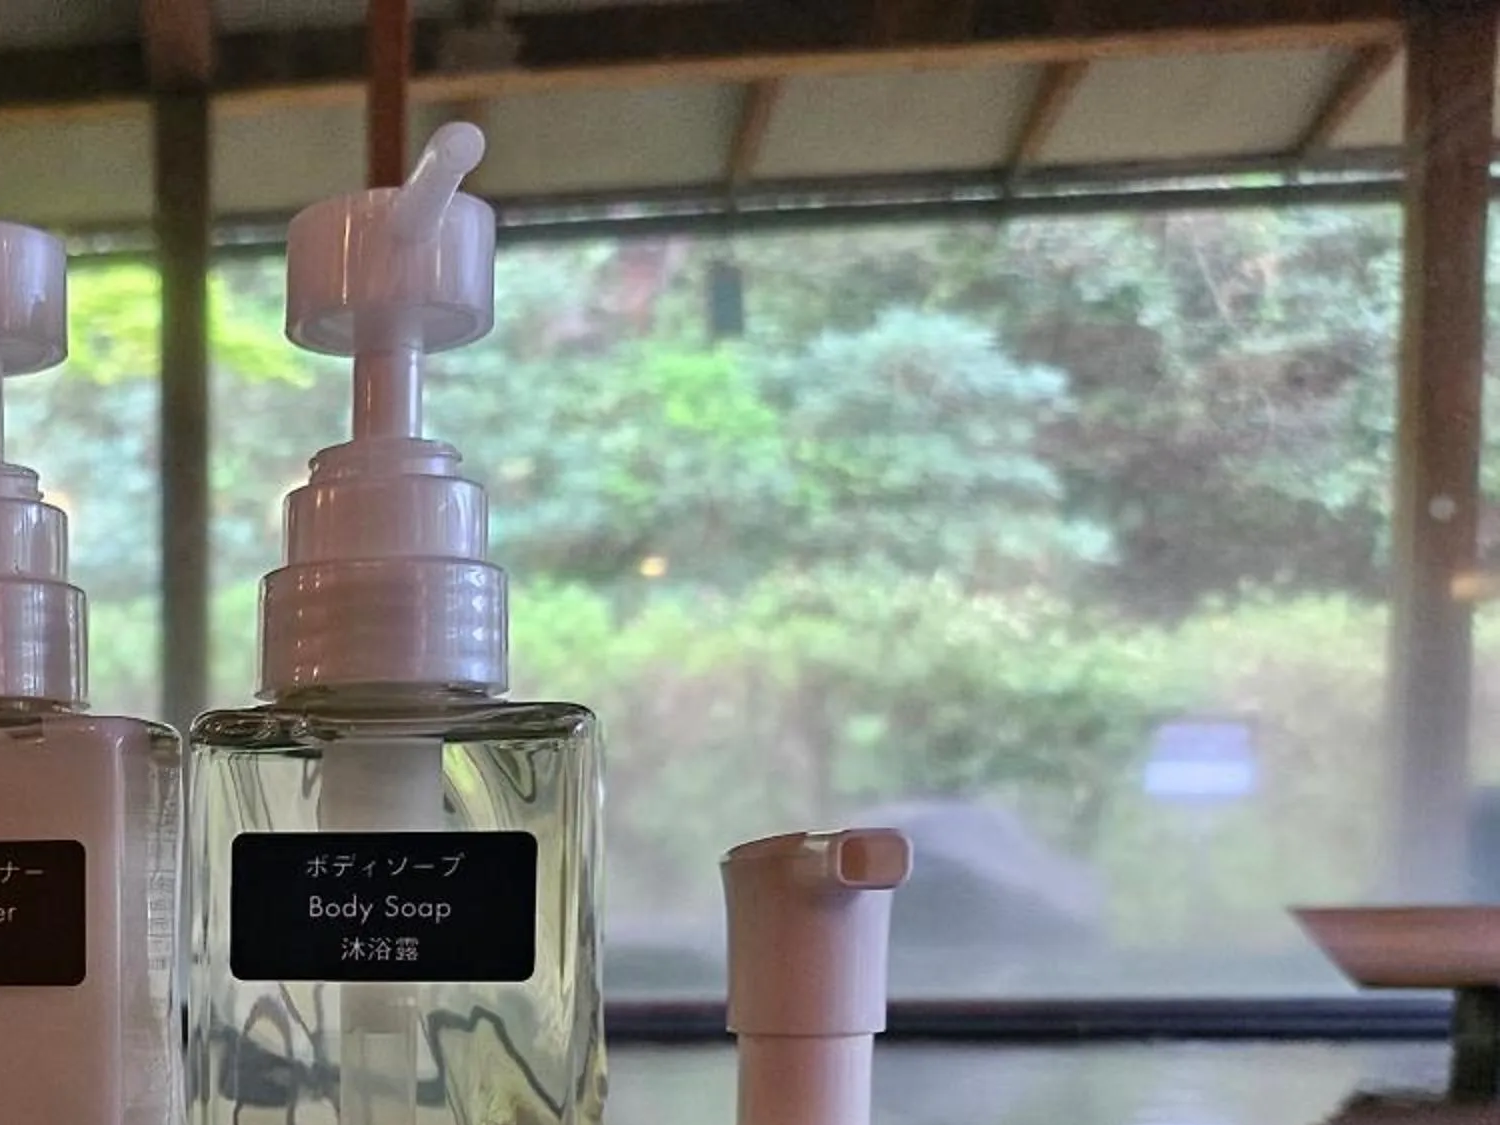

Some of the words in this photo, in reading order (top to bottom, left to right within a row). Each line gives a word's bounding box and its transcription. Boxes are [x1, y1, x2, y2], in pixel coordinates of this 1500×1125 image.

[308, 895, 374, 924] Body
[384, 895, 452, 923] Soap
[341, 936, 420, 962] 沐浴露
